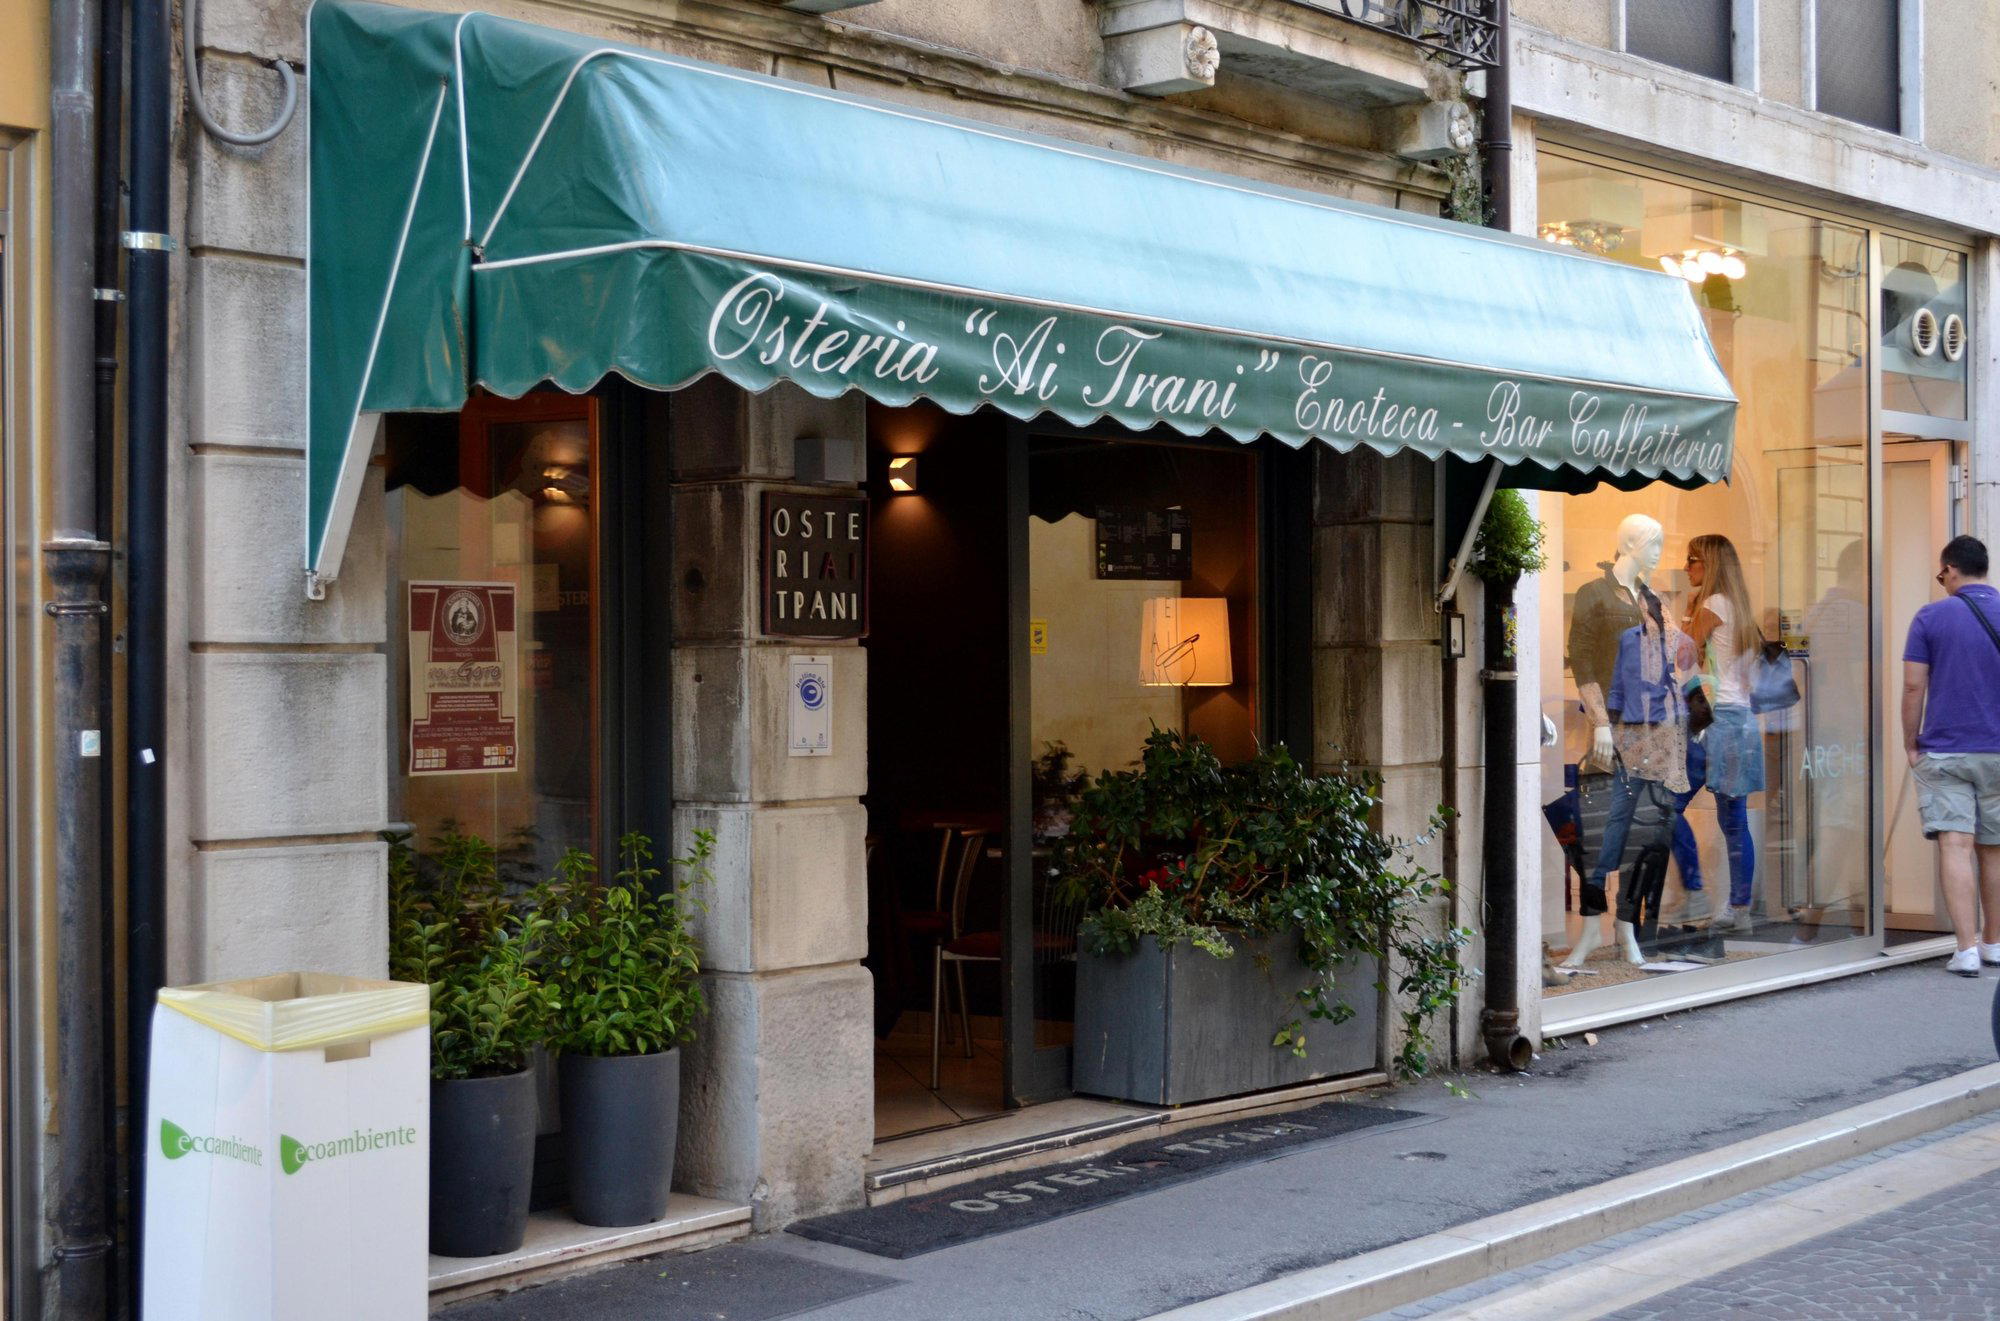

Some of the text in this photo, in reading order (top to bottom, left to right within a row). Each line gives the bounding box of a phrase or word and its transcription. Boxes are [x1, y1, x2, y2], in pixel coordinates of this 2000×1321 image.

[707, 271, 939, 384] Osteria
[1295, 355, 1439, 441] Enoteca
[1481, 380, 1552, 448] Bar
[1569, 390, 1725, 471] Caffetteria
[773, 508, 860, 540] OSTE
[178, 1125, 416, 1167] ecoambiente ecoambiente
